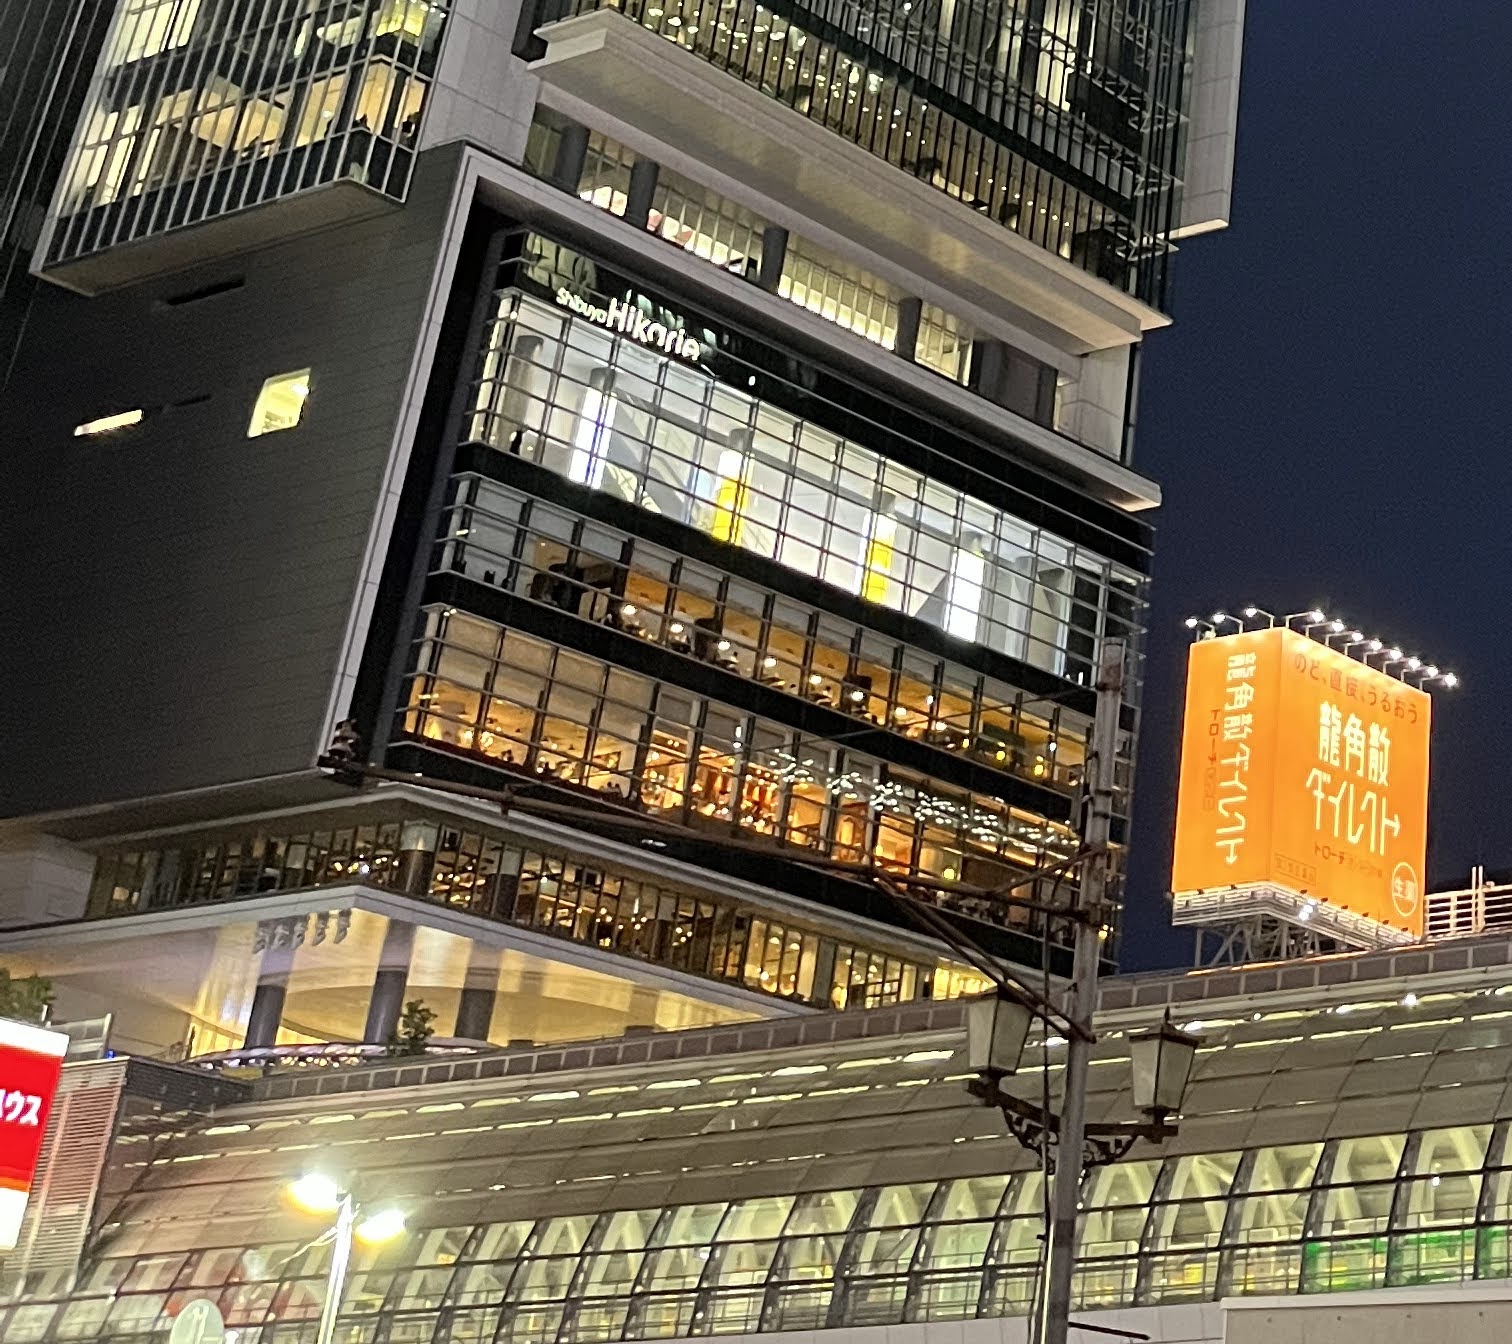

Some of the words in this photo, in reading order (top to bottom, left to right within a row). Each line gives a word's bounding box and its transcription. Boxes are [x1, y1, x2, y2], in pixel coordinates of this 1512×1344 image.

[555, 287, 608, 324] Shibuya
[605, 297, 701, 361] Hikarie
[1215, 652, 1257, 865] 龍角散ダイレクト
[1318, 700, 1391, 787] 龍角散
[1305, 767, 1401, 856] ダイレクト
